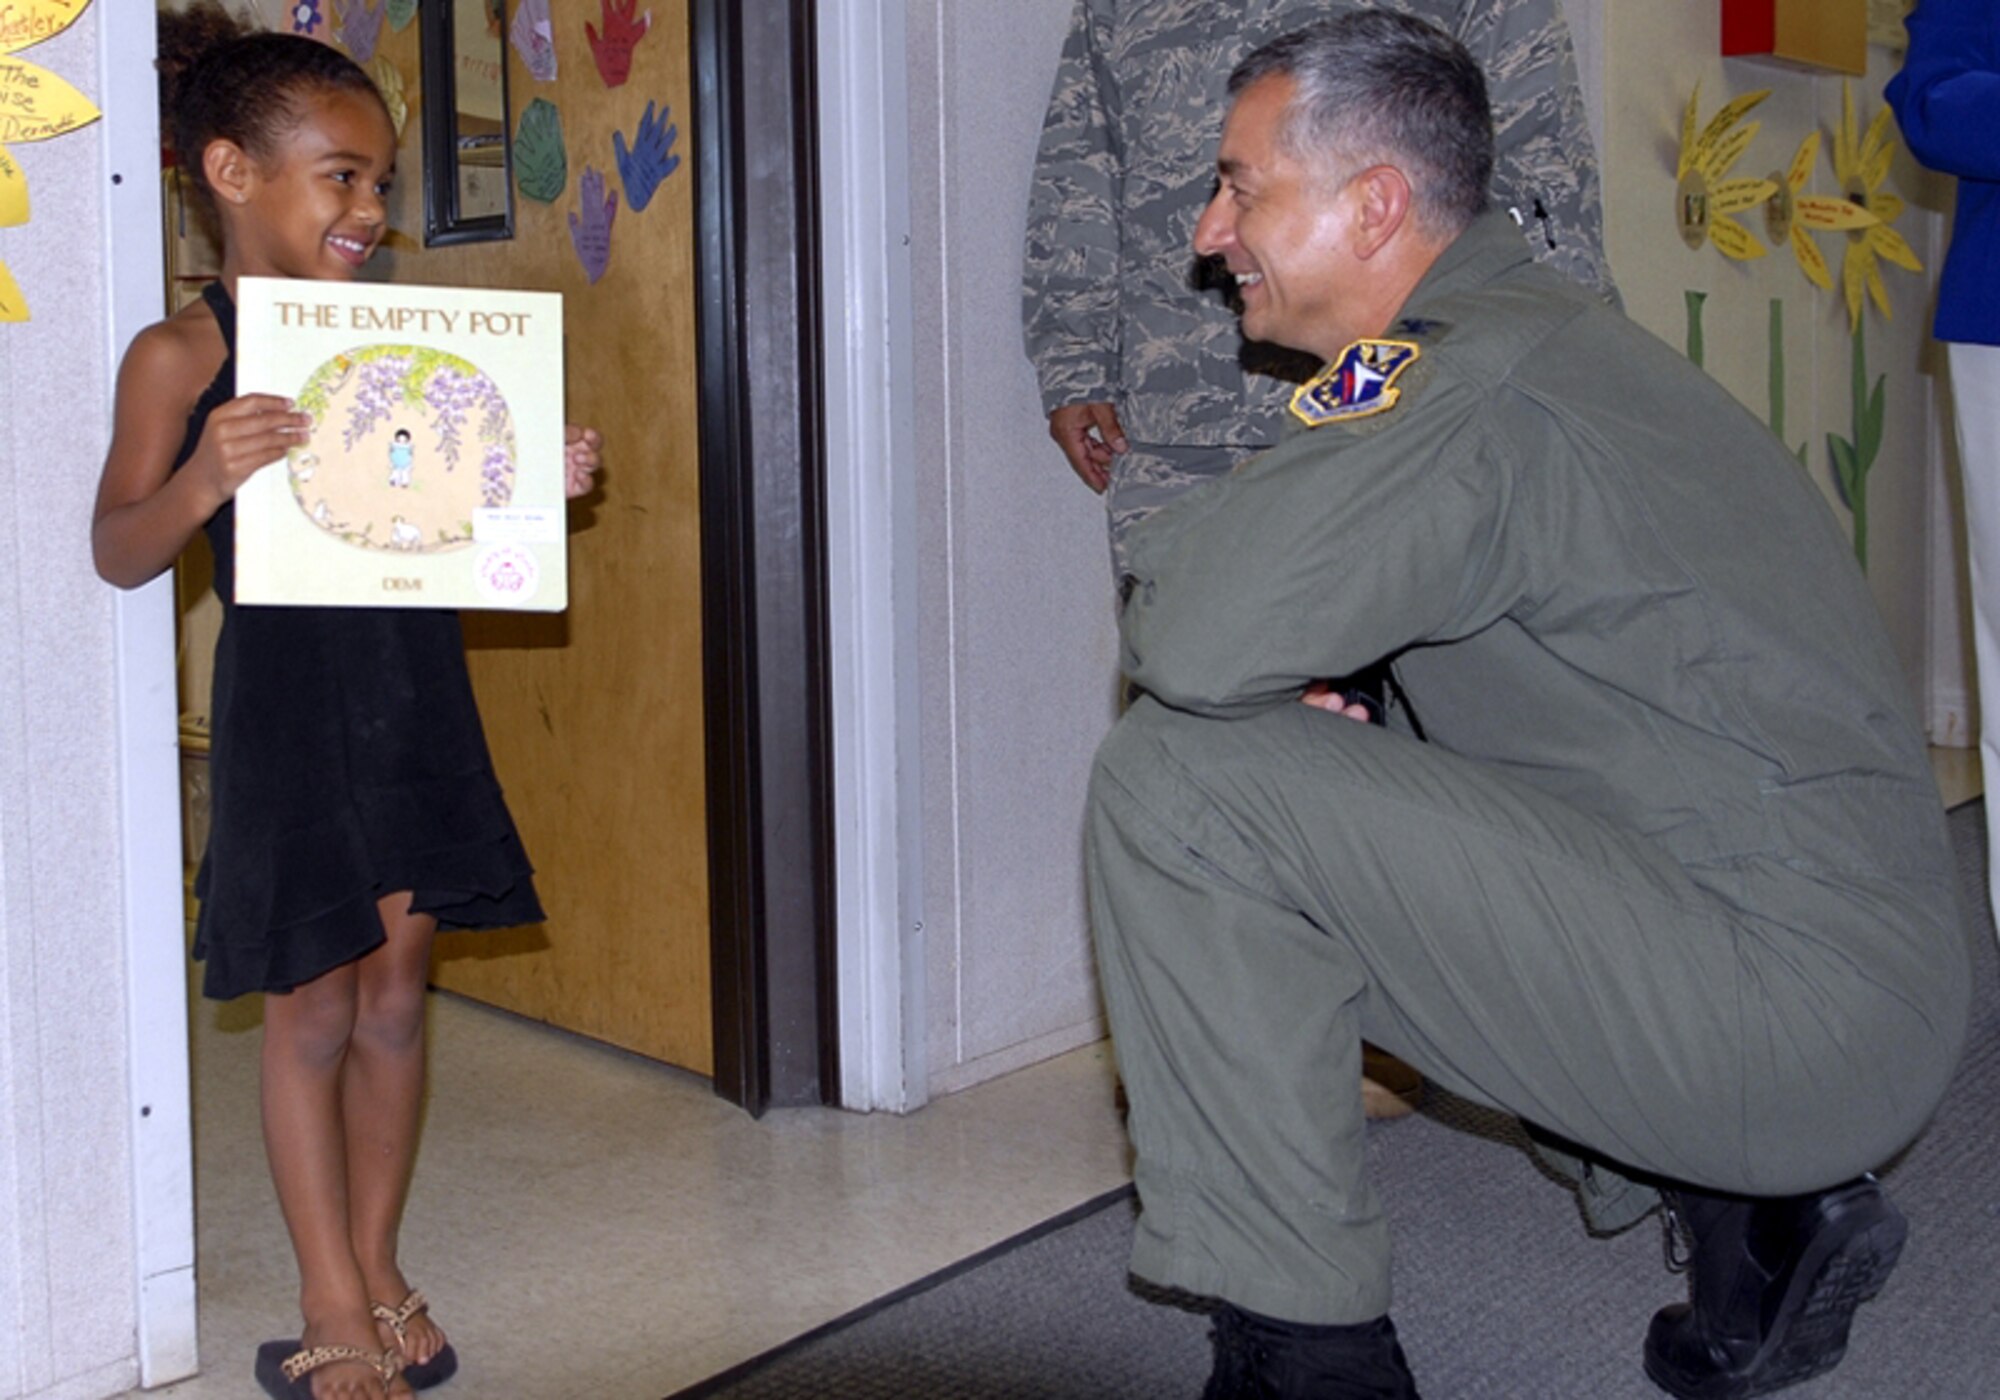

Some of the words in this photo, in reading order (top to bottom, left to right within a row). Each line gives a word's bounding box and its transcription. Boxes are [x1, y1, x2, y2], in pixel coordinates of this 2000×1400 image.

[274, 302, 339, 328] THE
[350, 305, 460, 334] EMPTY
[469, 311, 532, 337] POT
